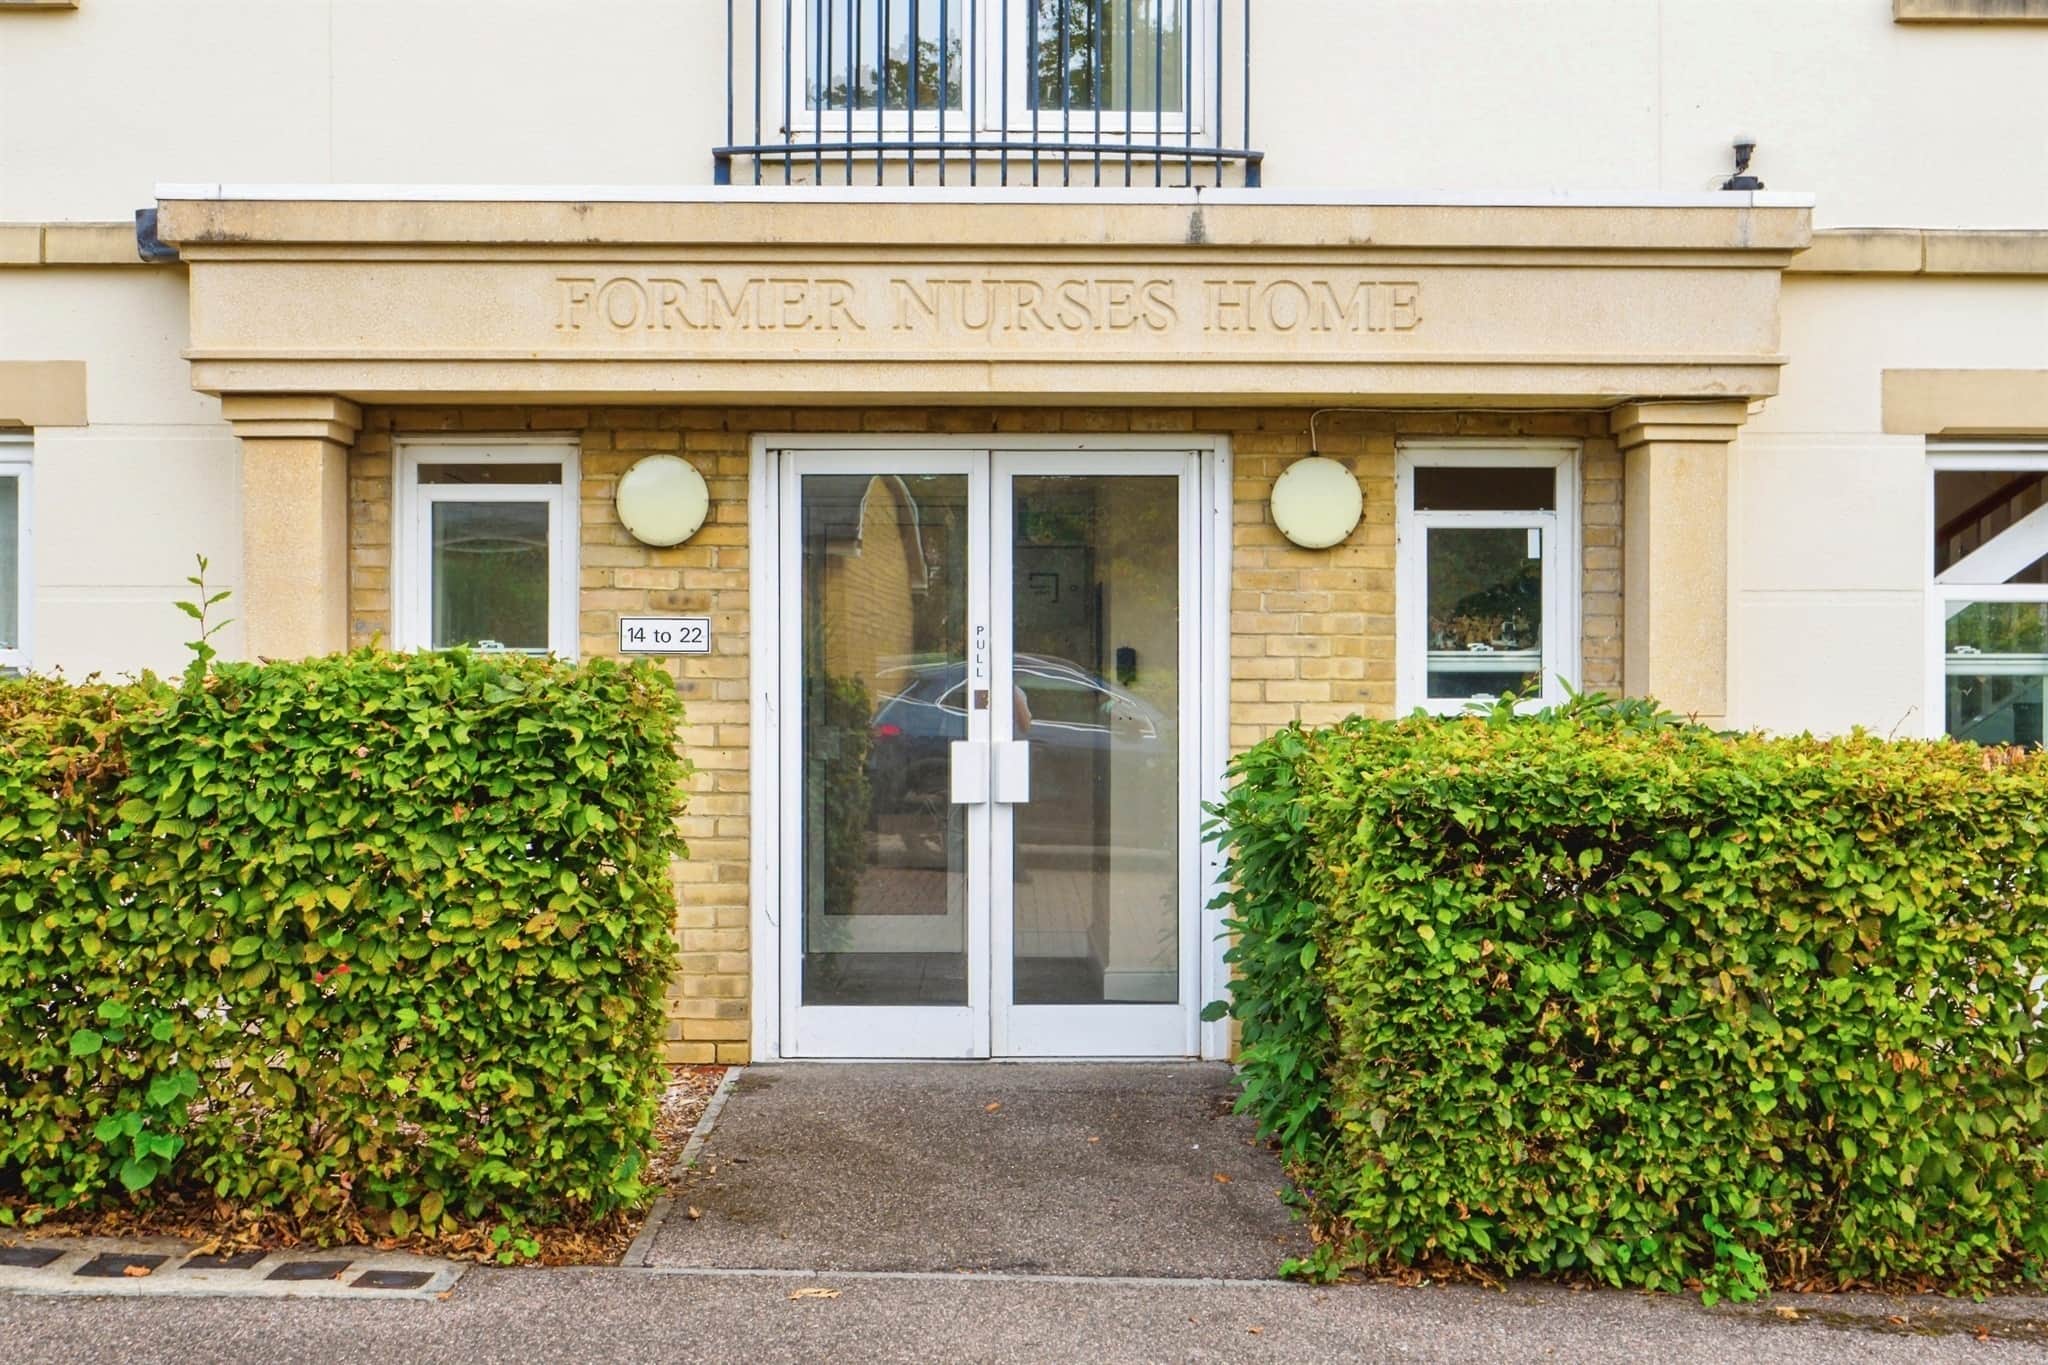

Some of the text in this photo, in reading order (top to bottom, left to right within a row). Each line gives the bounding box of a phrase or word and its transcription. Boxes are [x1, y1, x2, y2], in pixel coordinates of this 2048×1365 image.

[555, 276, 1423, 333] FORMER NURSES HOME
[627, 627, 703, 643] 14 to 22
[976, 625, 985, 678] PULL
